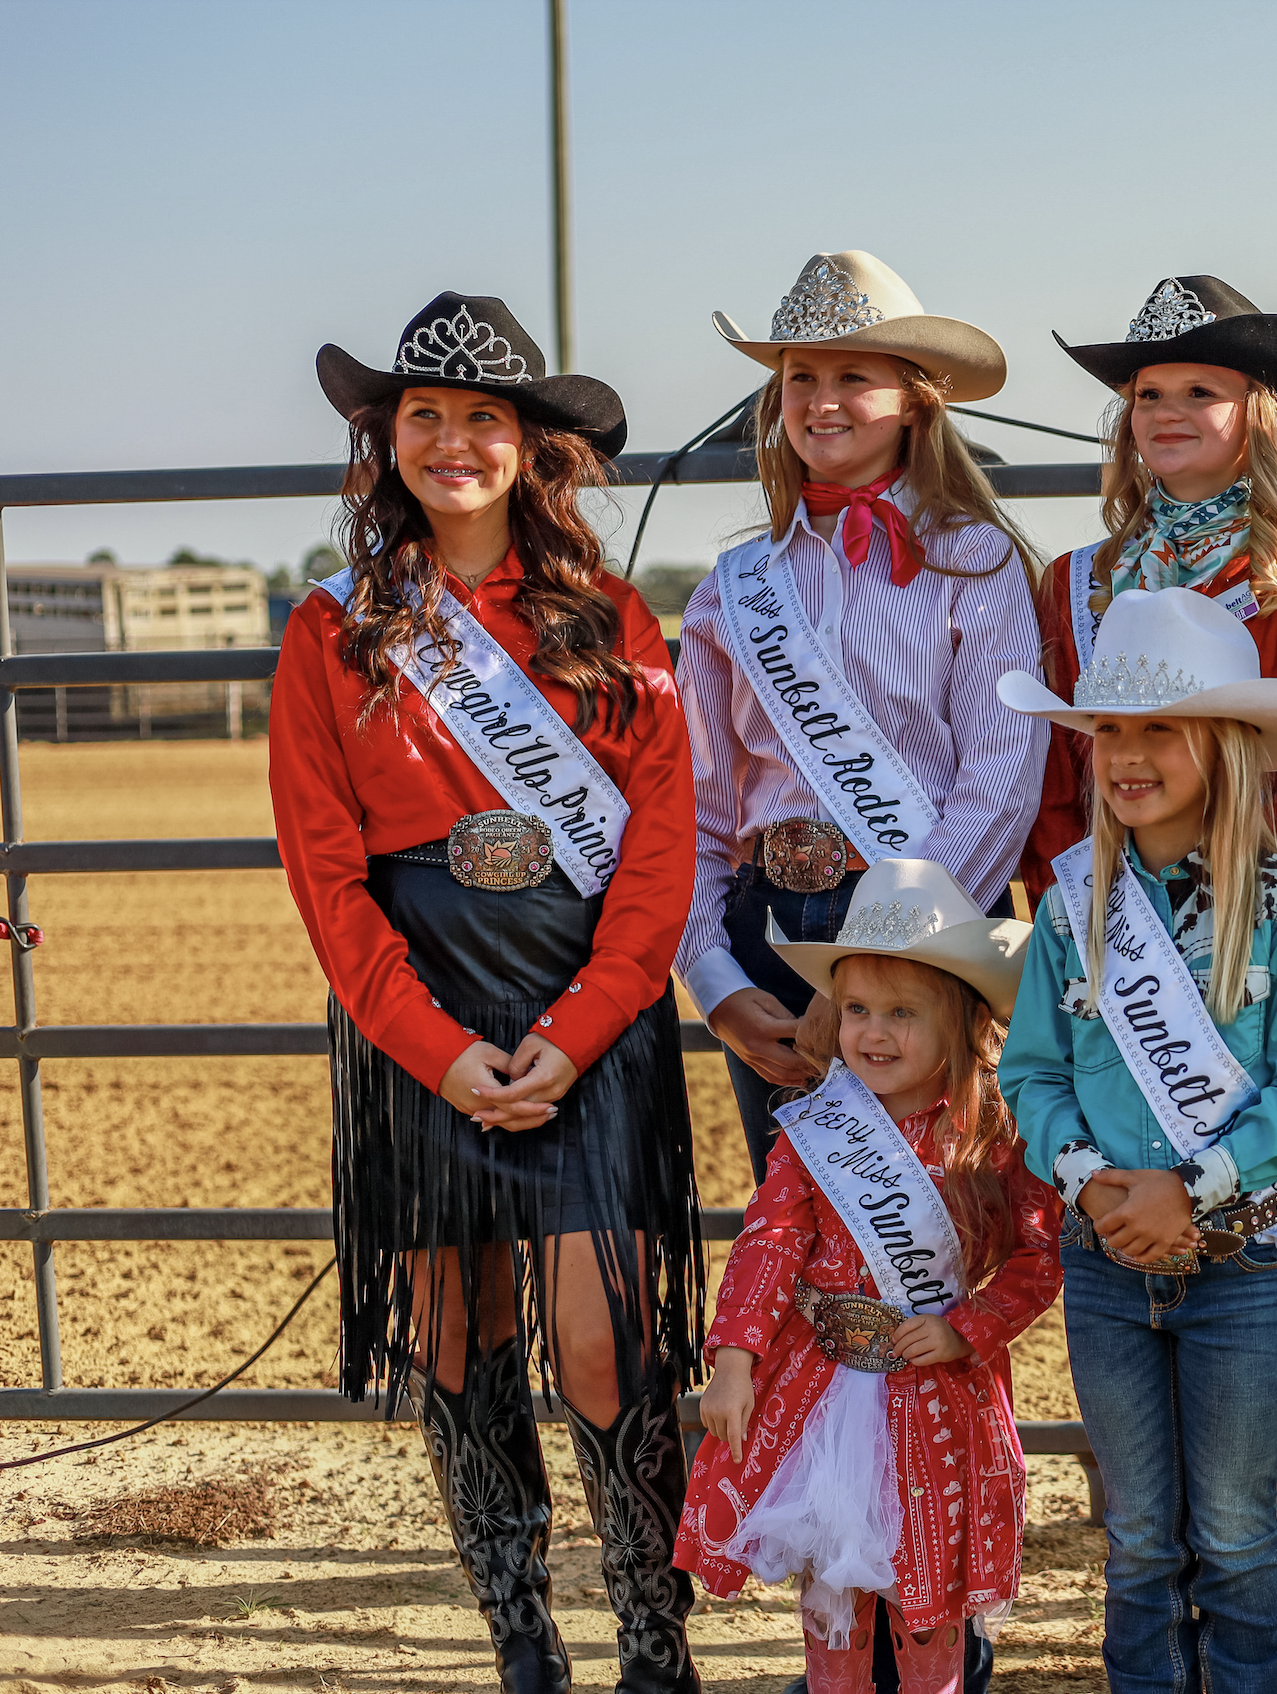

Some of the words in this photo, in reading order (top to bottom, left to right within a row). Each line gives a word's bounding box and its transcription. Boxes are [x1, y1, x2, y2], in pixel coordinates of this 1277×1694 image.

[738, 585, 785, 619] Miss
[749, 624, 852, 752] Sunbelt
[417, 639, 532, 750] Cowgirl
[505, 736, 560, 793] Up
[477, 816, 524, 828] SUNBELT
[822, 751, 910, 853] Rodeo
[477, 877, 524, 886] PRINCESS
[1113, 974, 1226, 1119] Sunbelt
[798, 1099, 876, 1145] Teeny
[827, 1146, 901, 1189] Miss
[858, 1192, 954, 1316] Sunbelt
[840, 1302, 882, 1317] SUNBELT
[880, 1335, 889, 1343] 24
